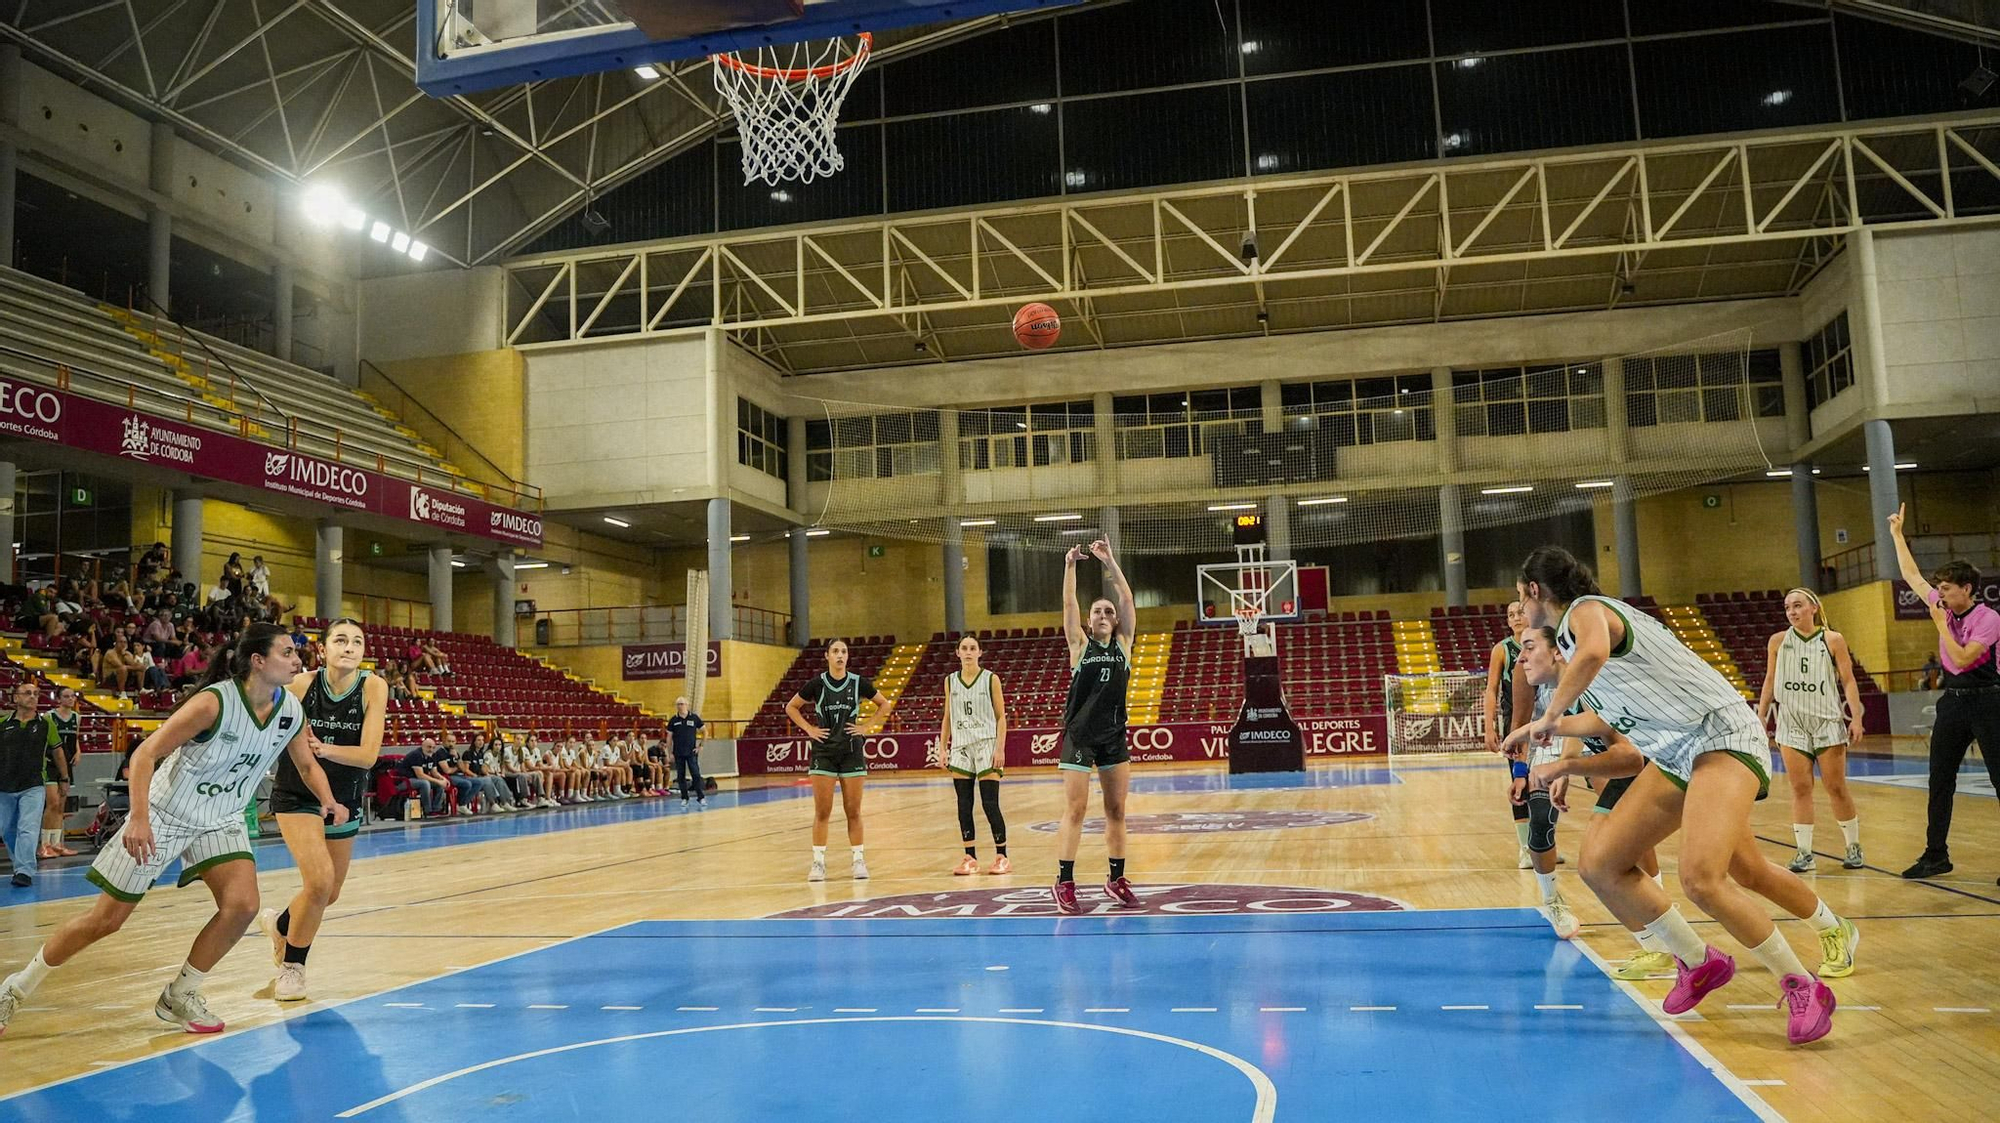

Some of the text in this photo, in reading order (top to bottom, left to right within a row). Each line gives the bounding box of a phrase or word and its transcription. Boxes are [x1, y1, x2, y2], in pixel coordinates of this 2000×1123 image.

[0, 421, 59, 440] ortes Córdoba
[151, 427, 201, 450] AYUNTAMIENTO
[151, 442, 194, 464] DE CÓRDOBA
[290, 456, 367, 495] IMDECO
[78, 488, 86, 501] D
[265, 479, 287, 492] Instituto
[288, 485, 313, 498] Municipal
[314, 491, 321, 499] de
[322, 492, 345, 504] Deportes
[431, 499, 465, 516] Diputación
[431, 511, 465, 527] de Córdoba
[502, 514, 542, 536] IMDECO
[872, 546, 880, 556] K
[1800, 657, 1809, 674] 6
[1100, 667, 1111, 682] 23
[963, 701, 973, 716] 16
[1311, 720, 1361, 730] DEPORTES
[1250, 730, 1291, 740] IMDECO
[229, 753, 262, 773] 24
[1142, 753, 1173, 761] Córdoba
[869, 762, 898, 770] Córdoba
